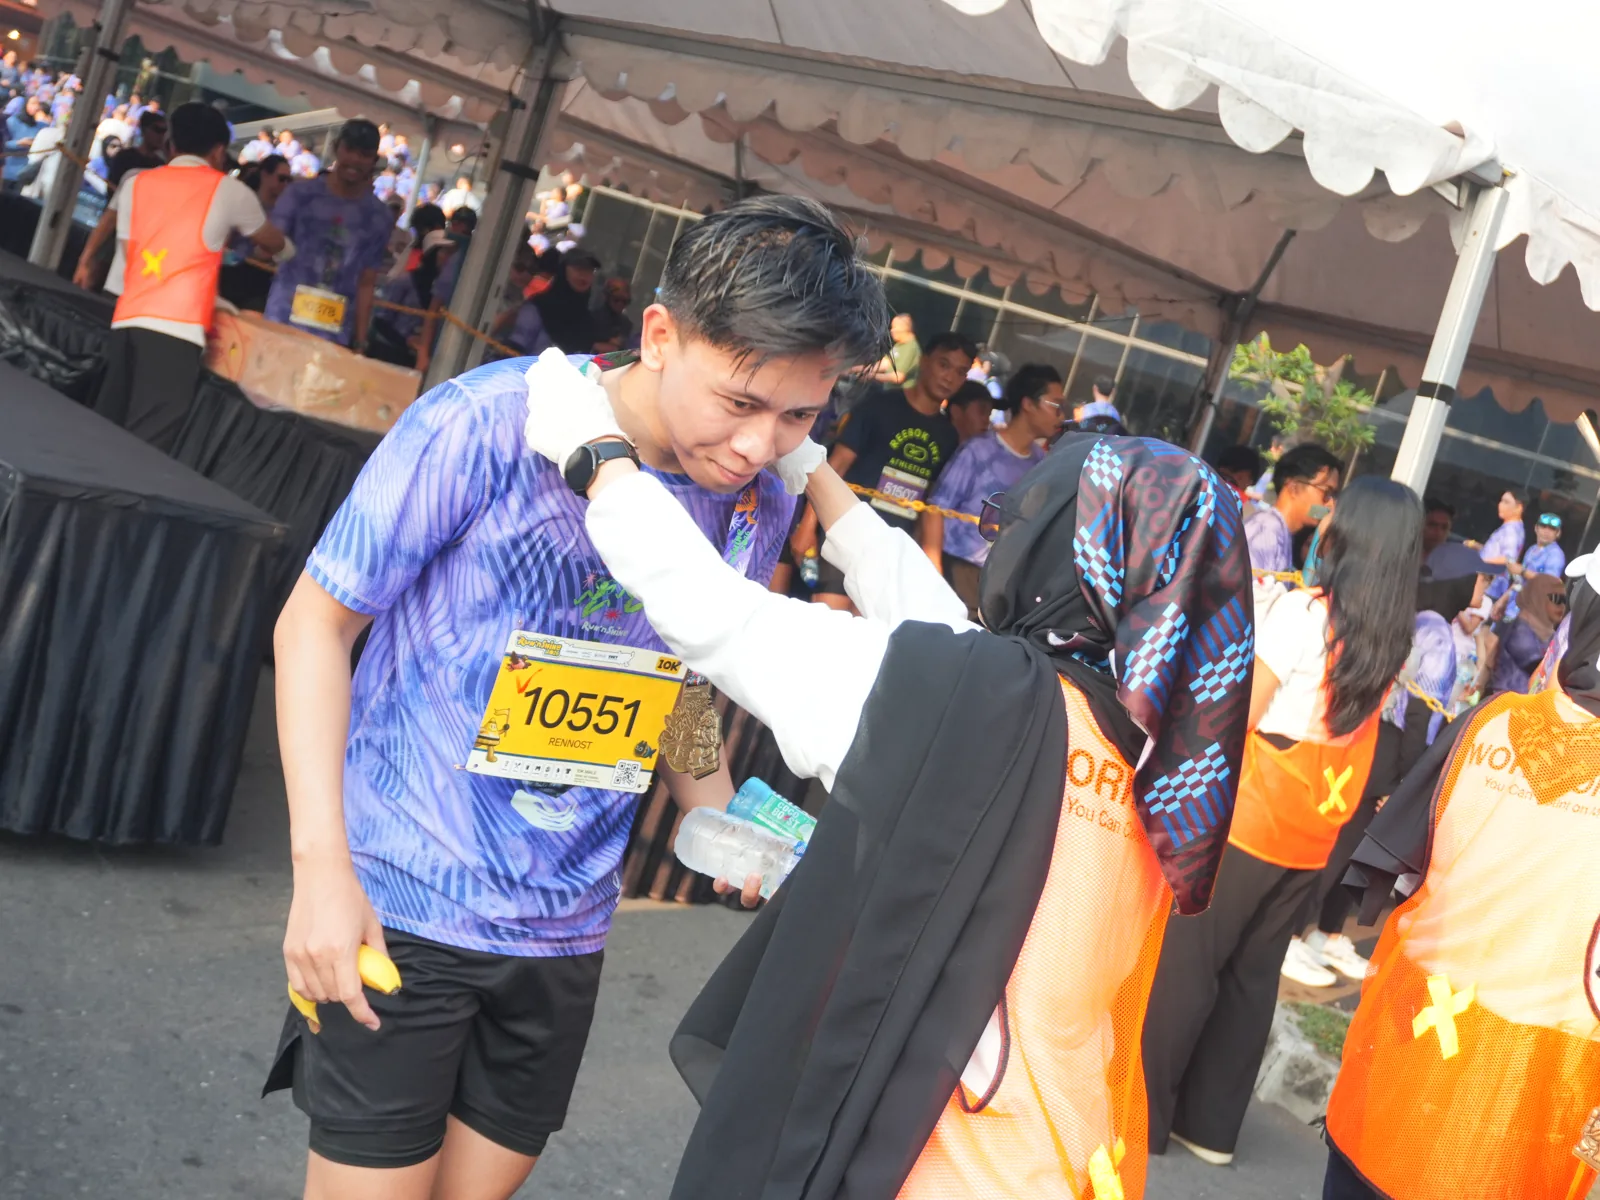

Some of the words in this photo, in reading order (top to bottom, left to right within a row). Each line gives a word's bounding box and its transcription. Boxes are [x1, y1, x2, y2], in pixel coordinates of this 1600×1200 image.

[890, 428, 929, 449] REEBOK
[883, 481, 919, 501] 51507
[657, 657, 681, 671] 10K
[523, 686, 642, 738] 10551
[548, 736, 593, 750] RENNOST
[1484, 775, 1506, 793] You
[1508, 783, 1533, 800] Can
[777, 801, 800, 819] COCO
[1067, 796, 1094, 822] You
[1099, 810, 1121, 834] Can
